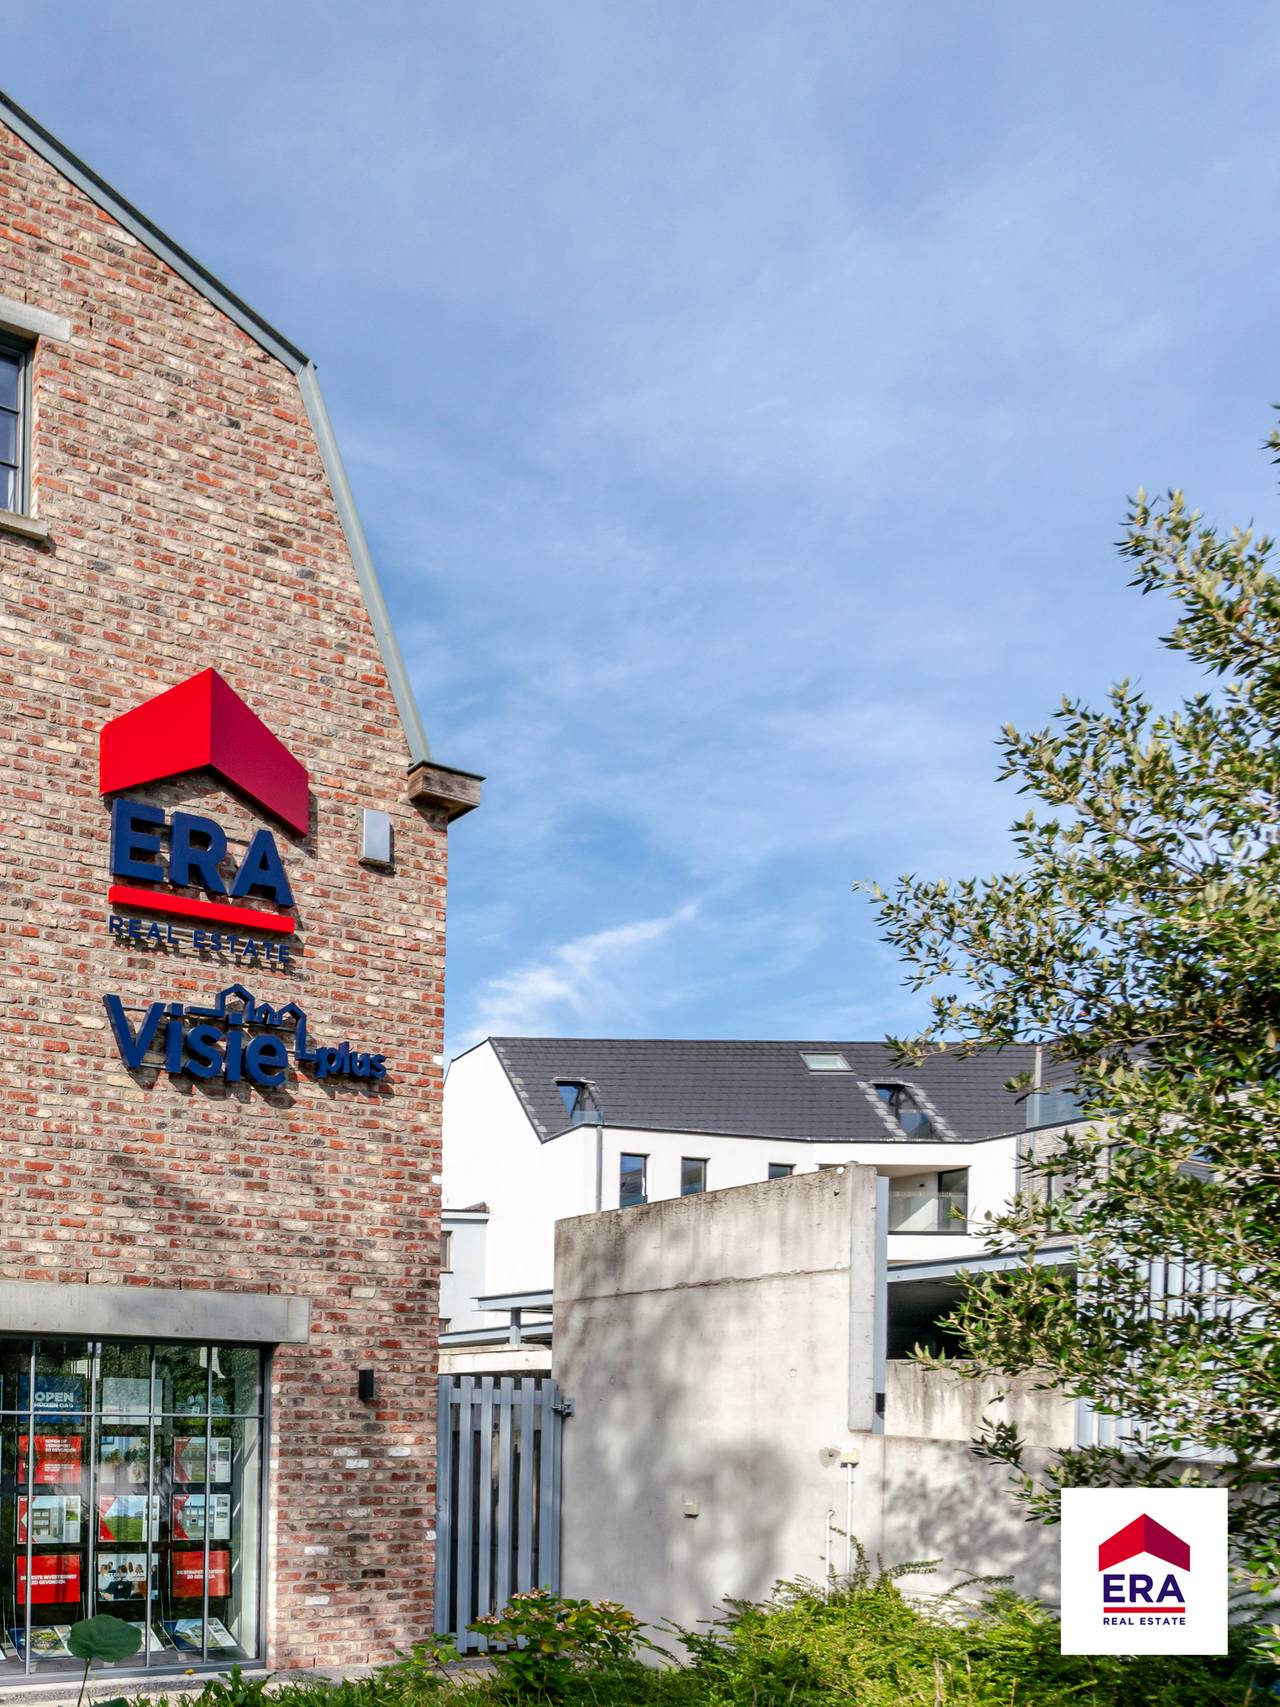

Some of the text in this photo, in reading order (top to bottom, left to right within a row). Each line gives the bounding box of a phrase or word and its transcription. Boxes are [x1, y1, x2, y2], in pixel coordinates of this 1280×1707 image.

[109, 798, 296, 907] ERA
[108, 914, 292, 963] REAL ESTATE
[102, 993, 387, 1088] Visie plus
[34, 1391, 74, 1402] OPEN
